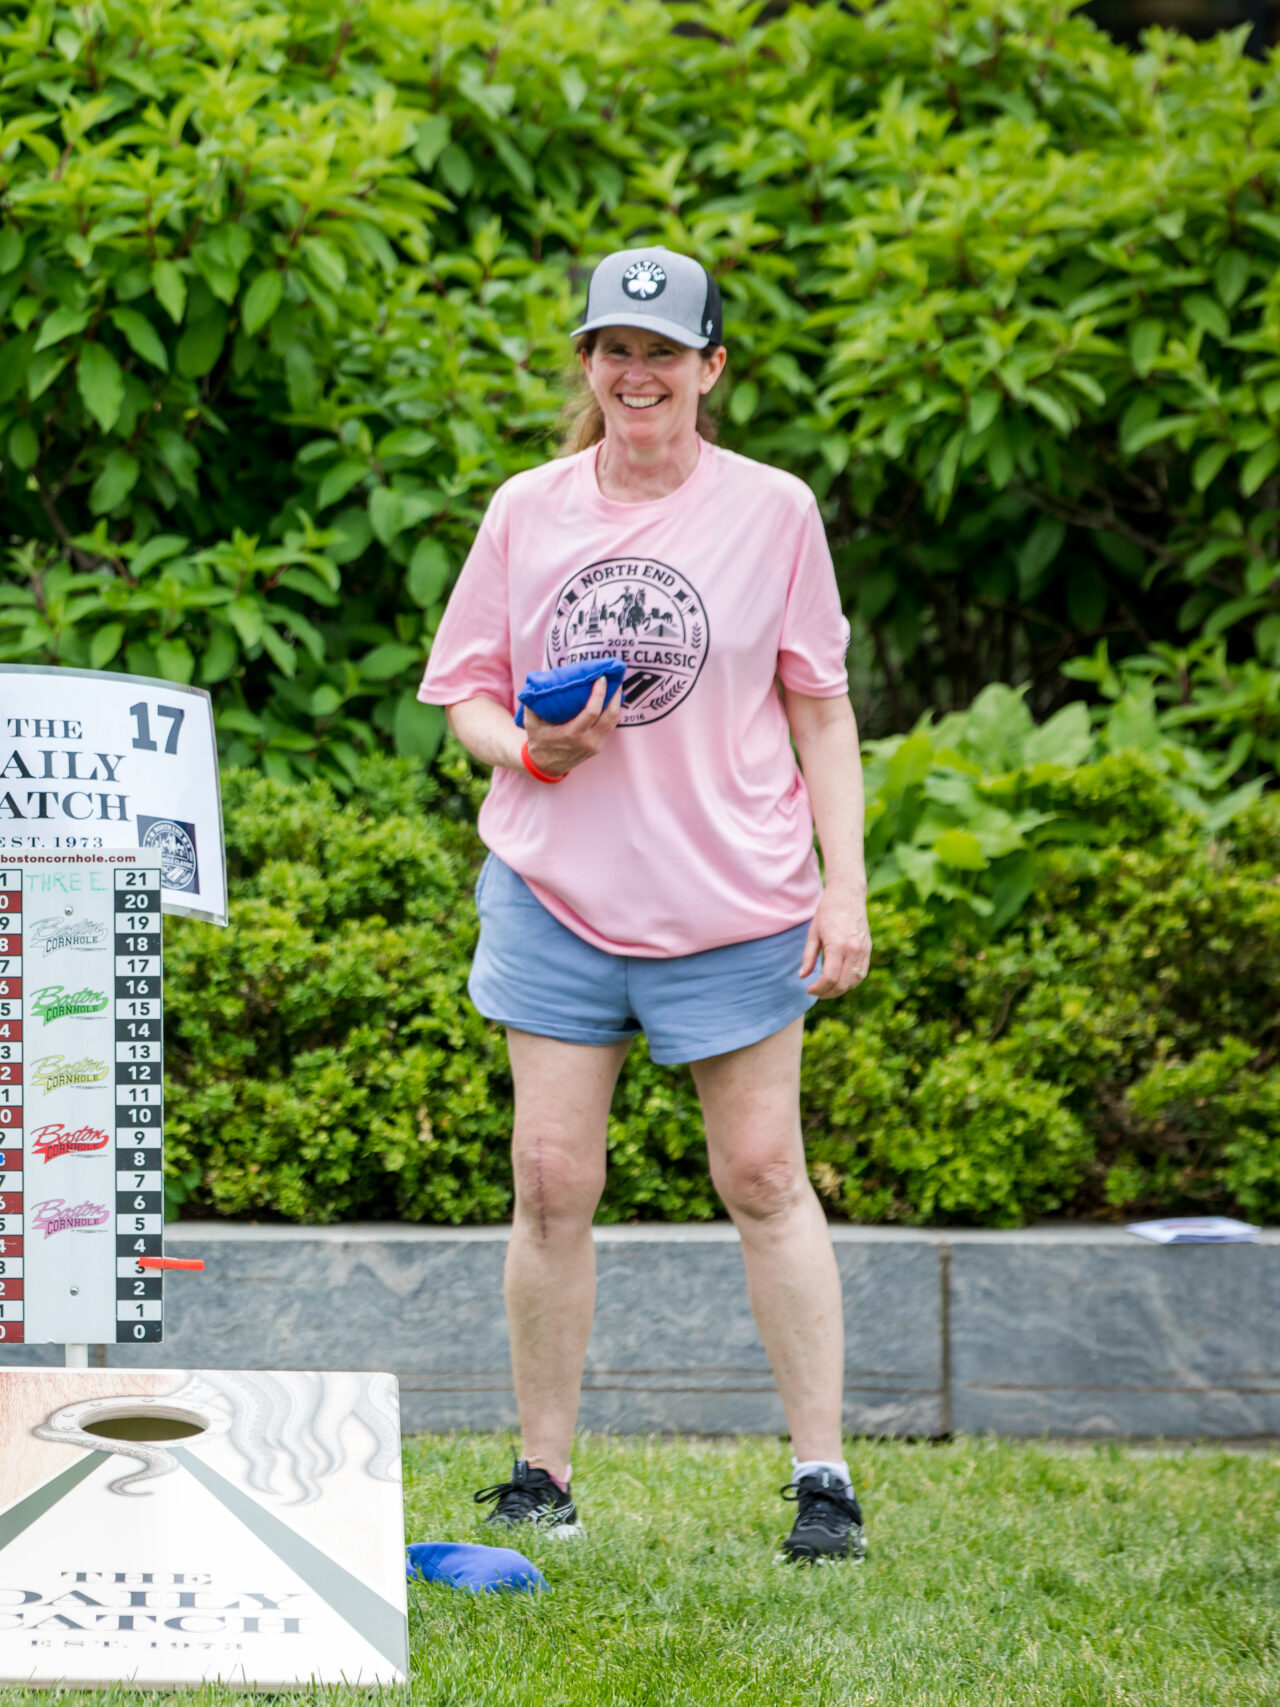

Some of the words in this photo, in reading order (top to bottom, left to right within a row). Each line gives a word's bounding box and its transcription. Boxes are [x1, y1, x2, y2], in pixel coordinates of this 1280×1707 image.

[625, 261, 666, 281] CELTICS
[580, 565, 638, 589] NORTH
[641, 565, 676, 587] END
[607, 638, 635, 647] 2026
[634, 651, 697, 669] CLASSIC
[7, 718, 83, 740] THE
[129, 701, 186, 755] 17
[53, 836, 104, 849] 1973
[0, 854, 136, 864] bostoncornhole.com
[26, 871, 108, 893] THREE
[126, 872, 146, 886] 21
[125, 894, 148, 908] 20
[127, 916, 149, 930] 19
[46, 936, 98, 953] CORNHOLE
[126, 937, 148, 951] 18
[128, 959, 149, 973] 17
[126, 980, 149, 994] 16
[46, 1005, 100, 1022] CORNHOLE
[128, 1002, 150, 1016] 15
[127, 1023, 150, 1037] 14
[129, 1045, 150, 1059] 13
[128, 1066, 151, 1080] 12
[46, 1074, 100, 1091] CORNHOLE
[129, 1088, 148, 1102] 11
[128, 1108, 151, 1123] 10
[30, 1123, 106, 1148] Boston
[134, 1131, 145, 1145] 9
[134, 1152, 145, 1166] 8
[134, 1174, 145, 1188] 7
[134, 1195, 145, 1209] 6
[47, 1218, 100, 1236] CORNHOLE
[135, 1217, 145, 1231] 5
[134, 1239, 146, 1252] 4
[134, 1281, 145, 1295] 2
[136, 1304, 143, 1317] 1
[133, 1325, 146, 1339] 0
[60, 1571, 212, 1585] THE
